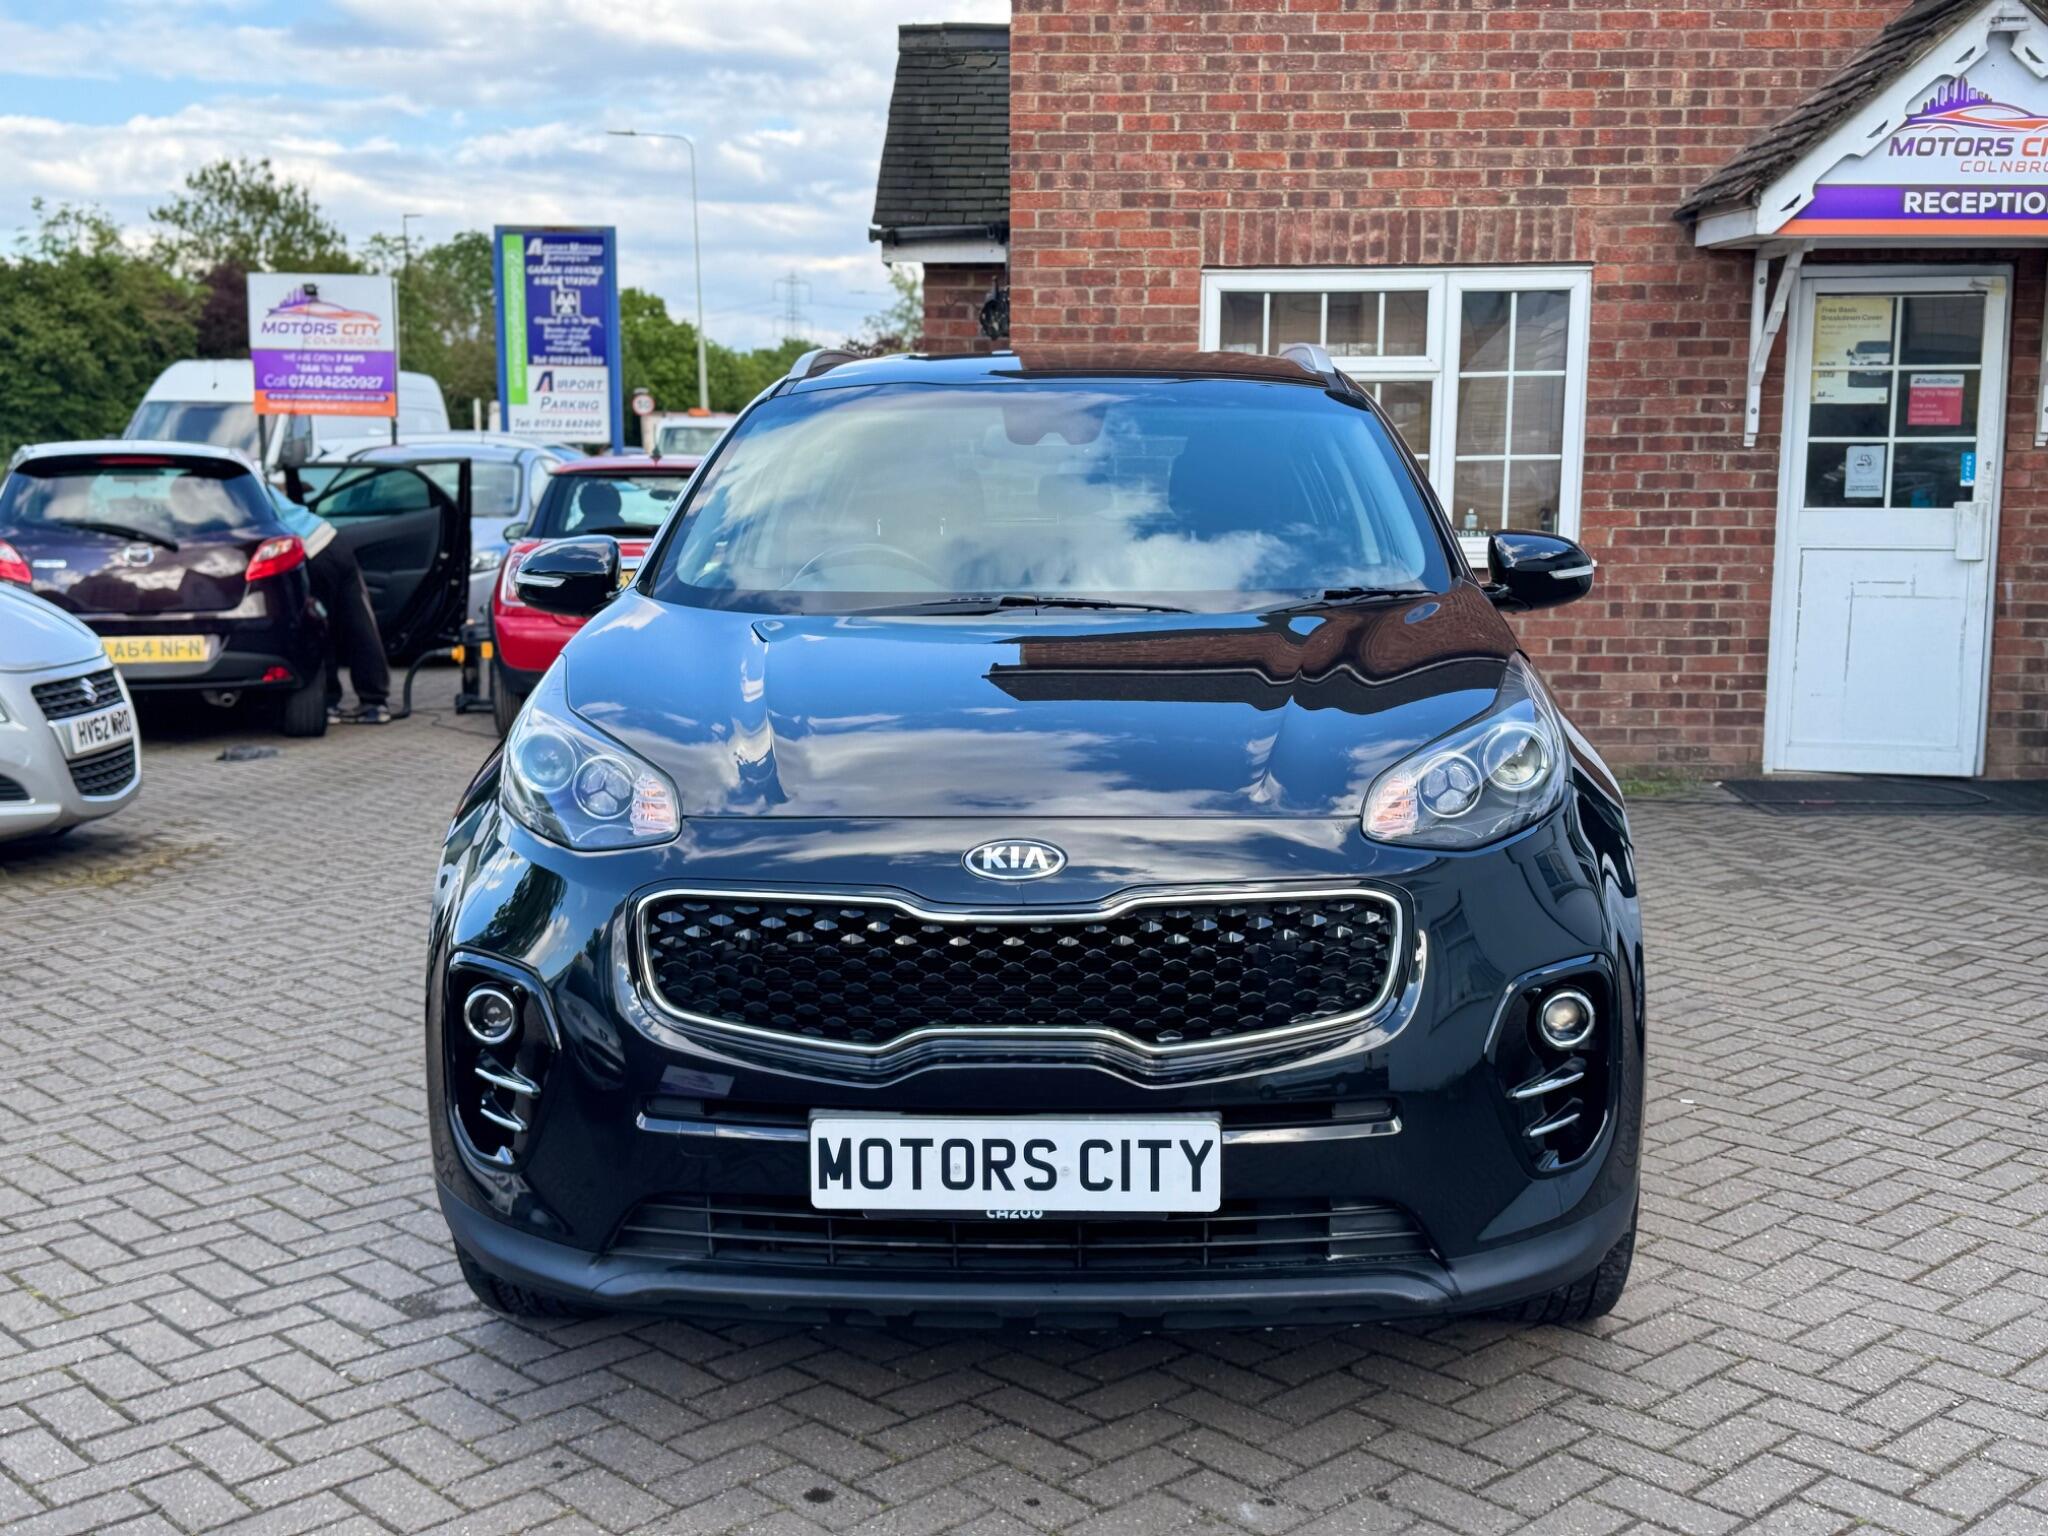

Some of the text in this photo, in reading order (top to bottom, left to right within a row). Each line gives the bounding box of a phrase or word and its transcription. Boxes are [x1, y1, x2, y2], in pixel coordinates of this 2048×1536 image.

[1888, 137, 2014, 157] MOTORS
[1904, 191, 2048, 214] RECEPTIO
[261, 321, 383, 336] MOTORS CITY
[263, 374, 287, 387] Call
[535, 371, 603, 392] AIRPORT
[540, 396, 600, 410] PARKING
[113, 638, 154, 657] A64
[982, 845, 1049, 870] KIA
[817, 1137, 1214, 1193] MOTORS CITY
